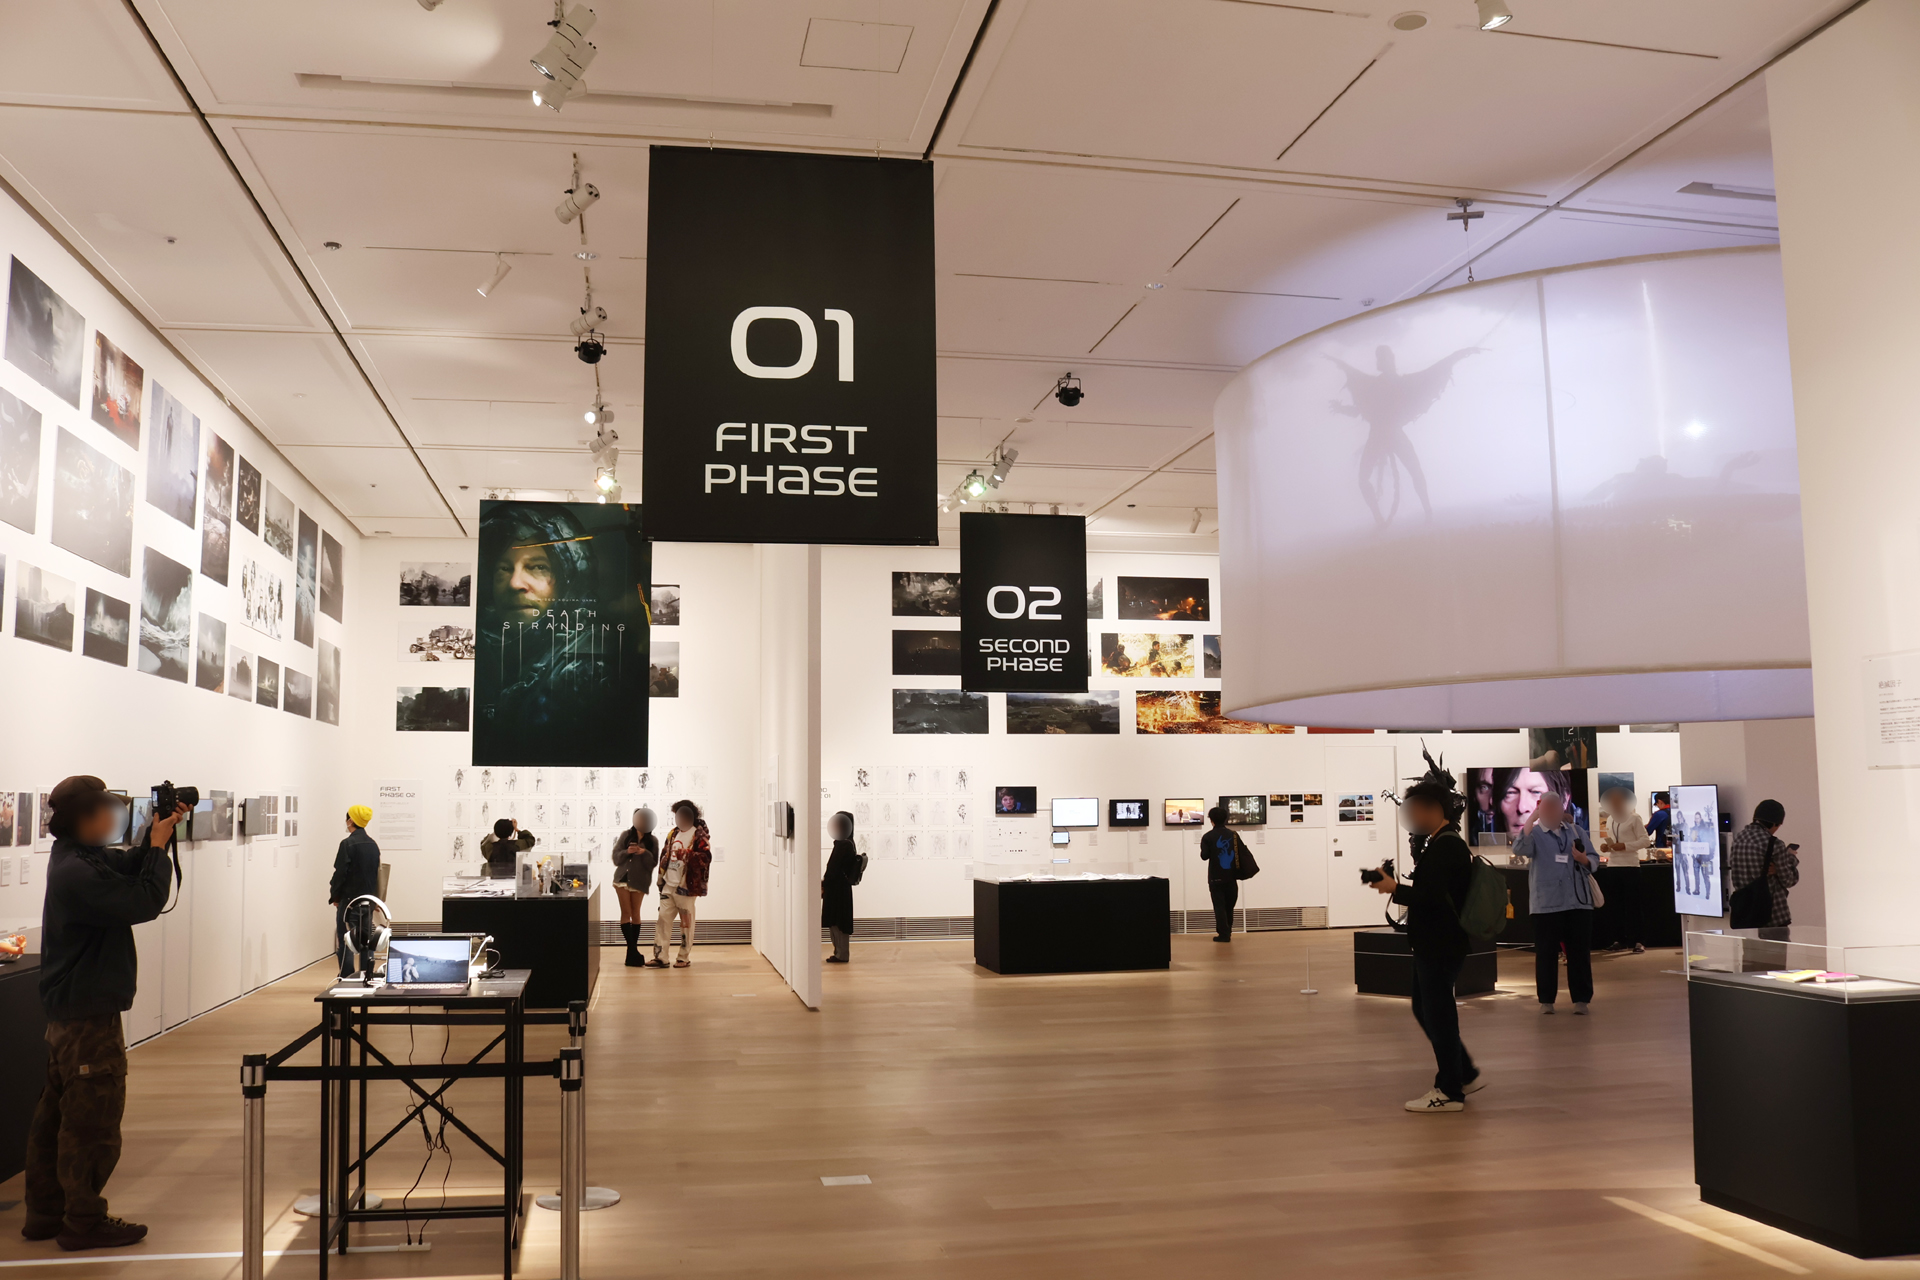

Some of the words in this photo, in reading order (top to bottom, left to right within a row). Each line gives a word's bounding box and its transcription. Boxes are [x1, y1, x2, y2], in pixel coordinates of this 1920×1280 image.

[730, 305, 855, 382] 01
[715, 422, 868, 455] FIRST
[986, 585, 1062, 621] 02
[532, 608, 597, 618] DEATH
[502, 621, 626, 632] STRANDING
[979, 638, 1071, 654] SECOND
[987, 657, 1063, 672] PHASE
